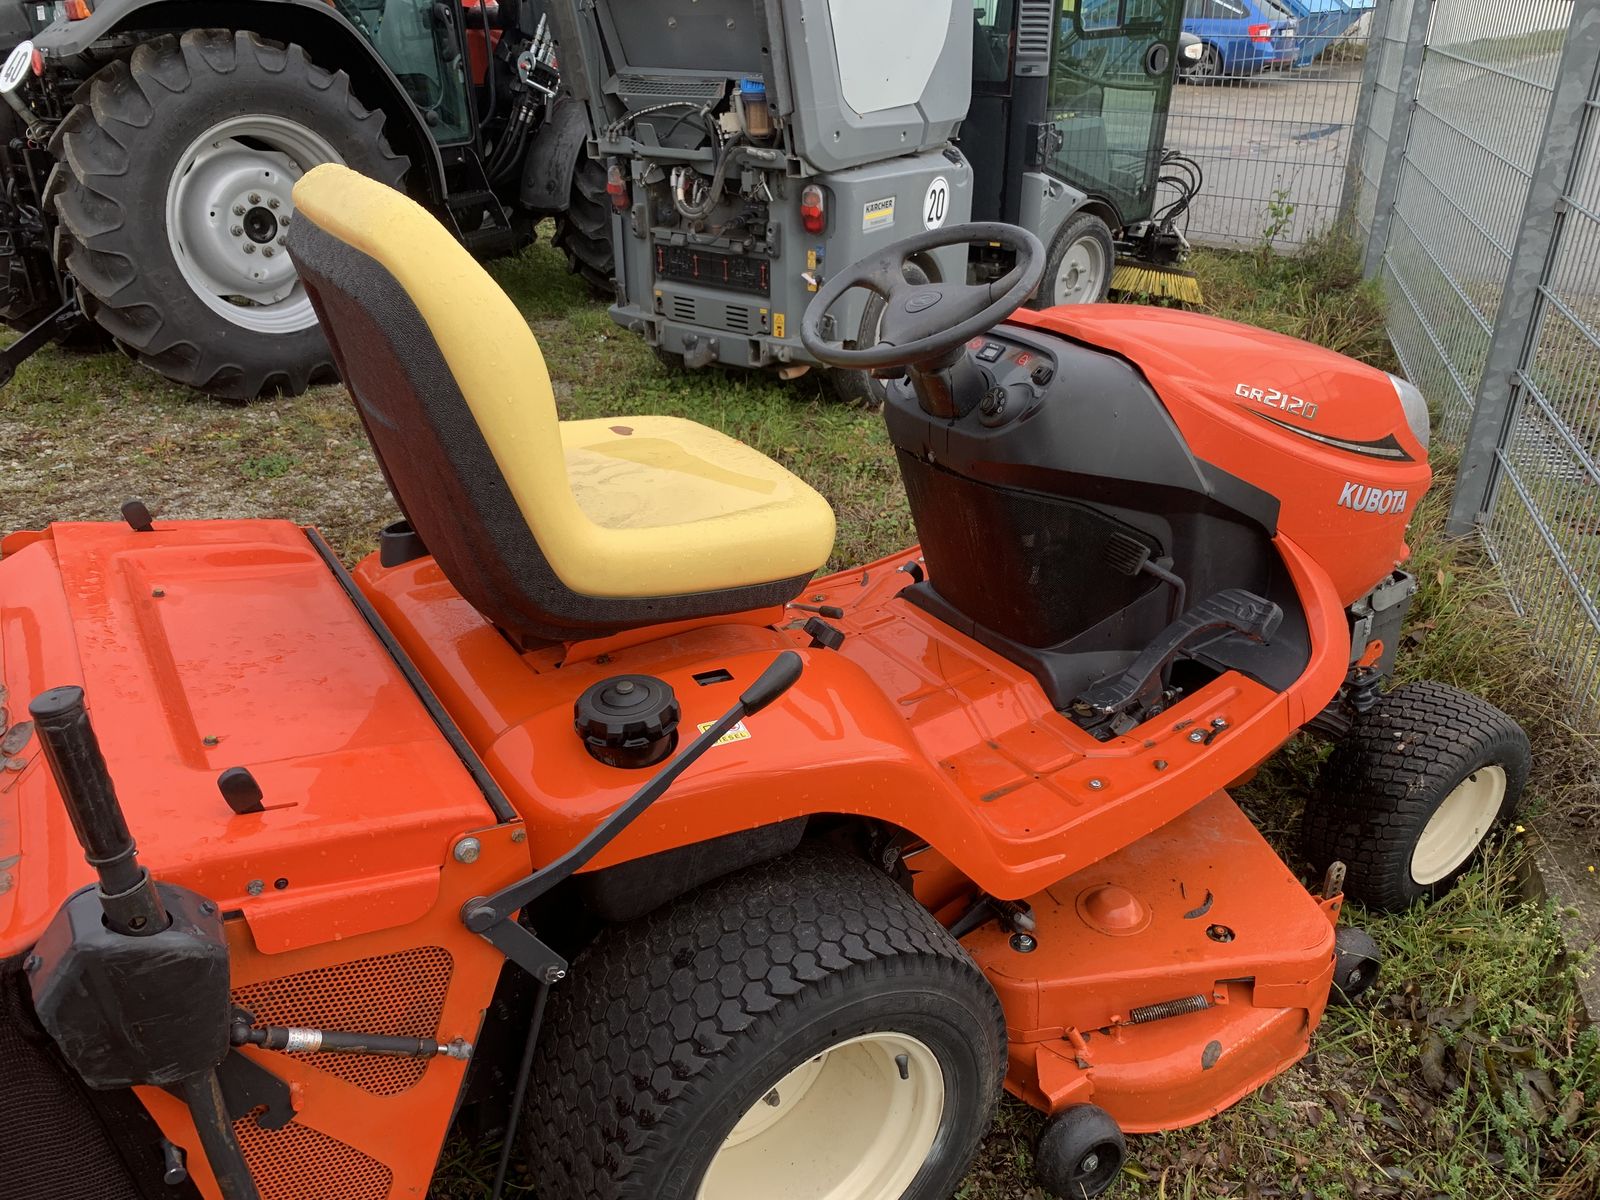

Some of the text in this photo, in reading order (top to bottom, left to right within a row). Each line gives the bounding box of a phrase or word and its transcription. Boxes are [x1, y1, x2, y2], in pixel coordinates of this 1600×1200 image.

[5, 50, 28, 83] 40
[927, 188, 945, 222] 20
[1235, 383, 1319, 420] GR2120
[1337, 481, 1408, 515] KUBOTA
[717, 731, 747, 744] IESEL
